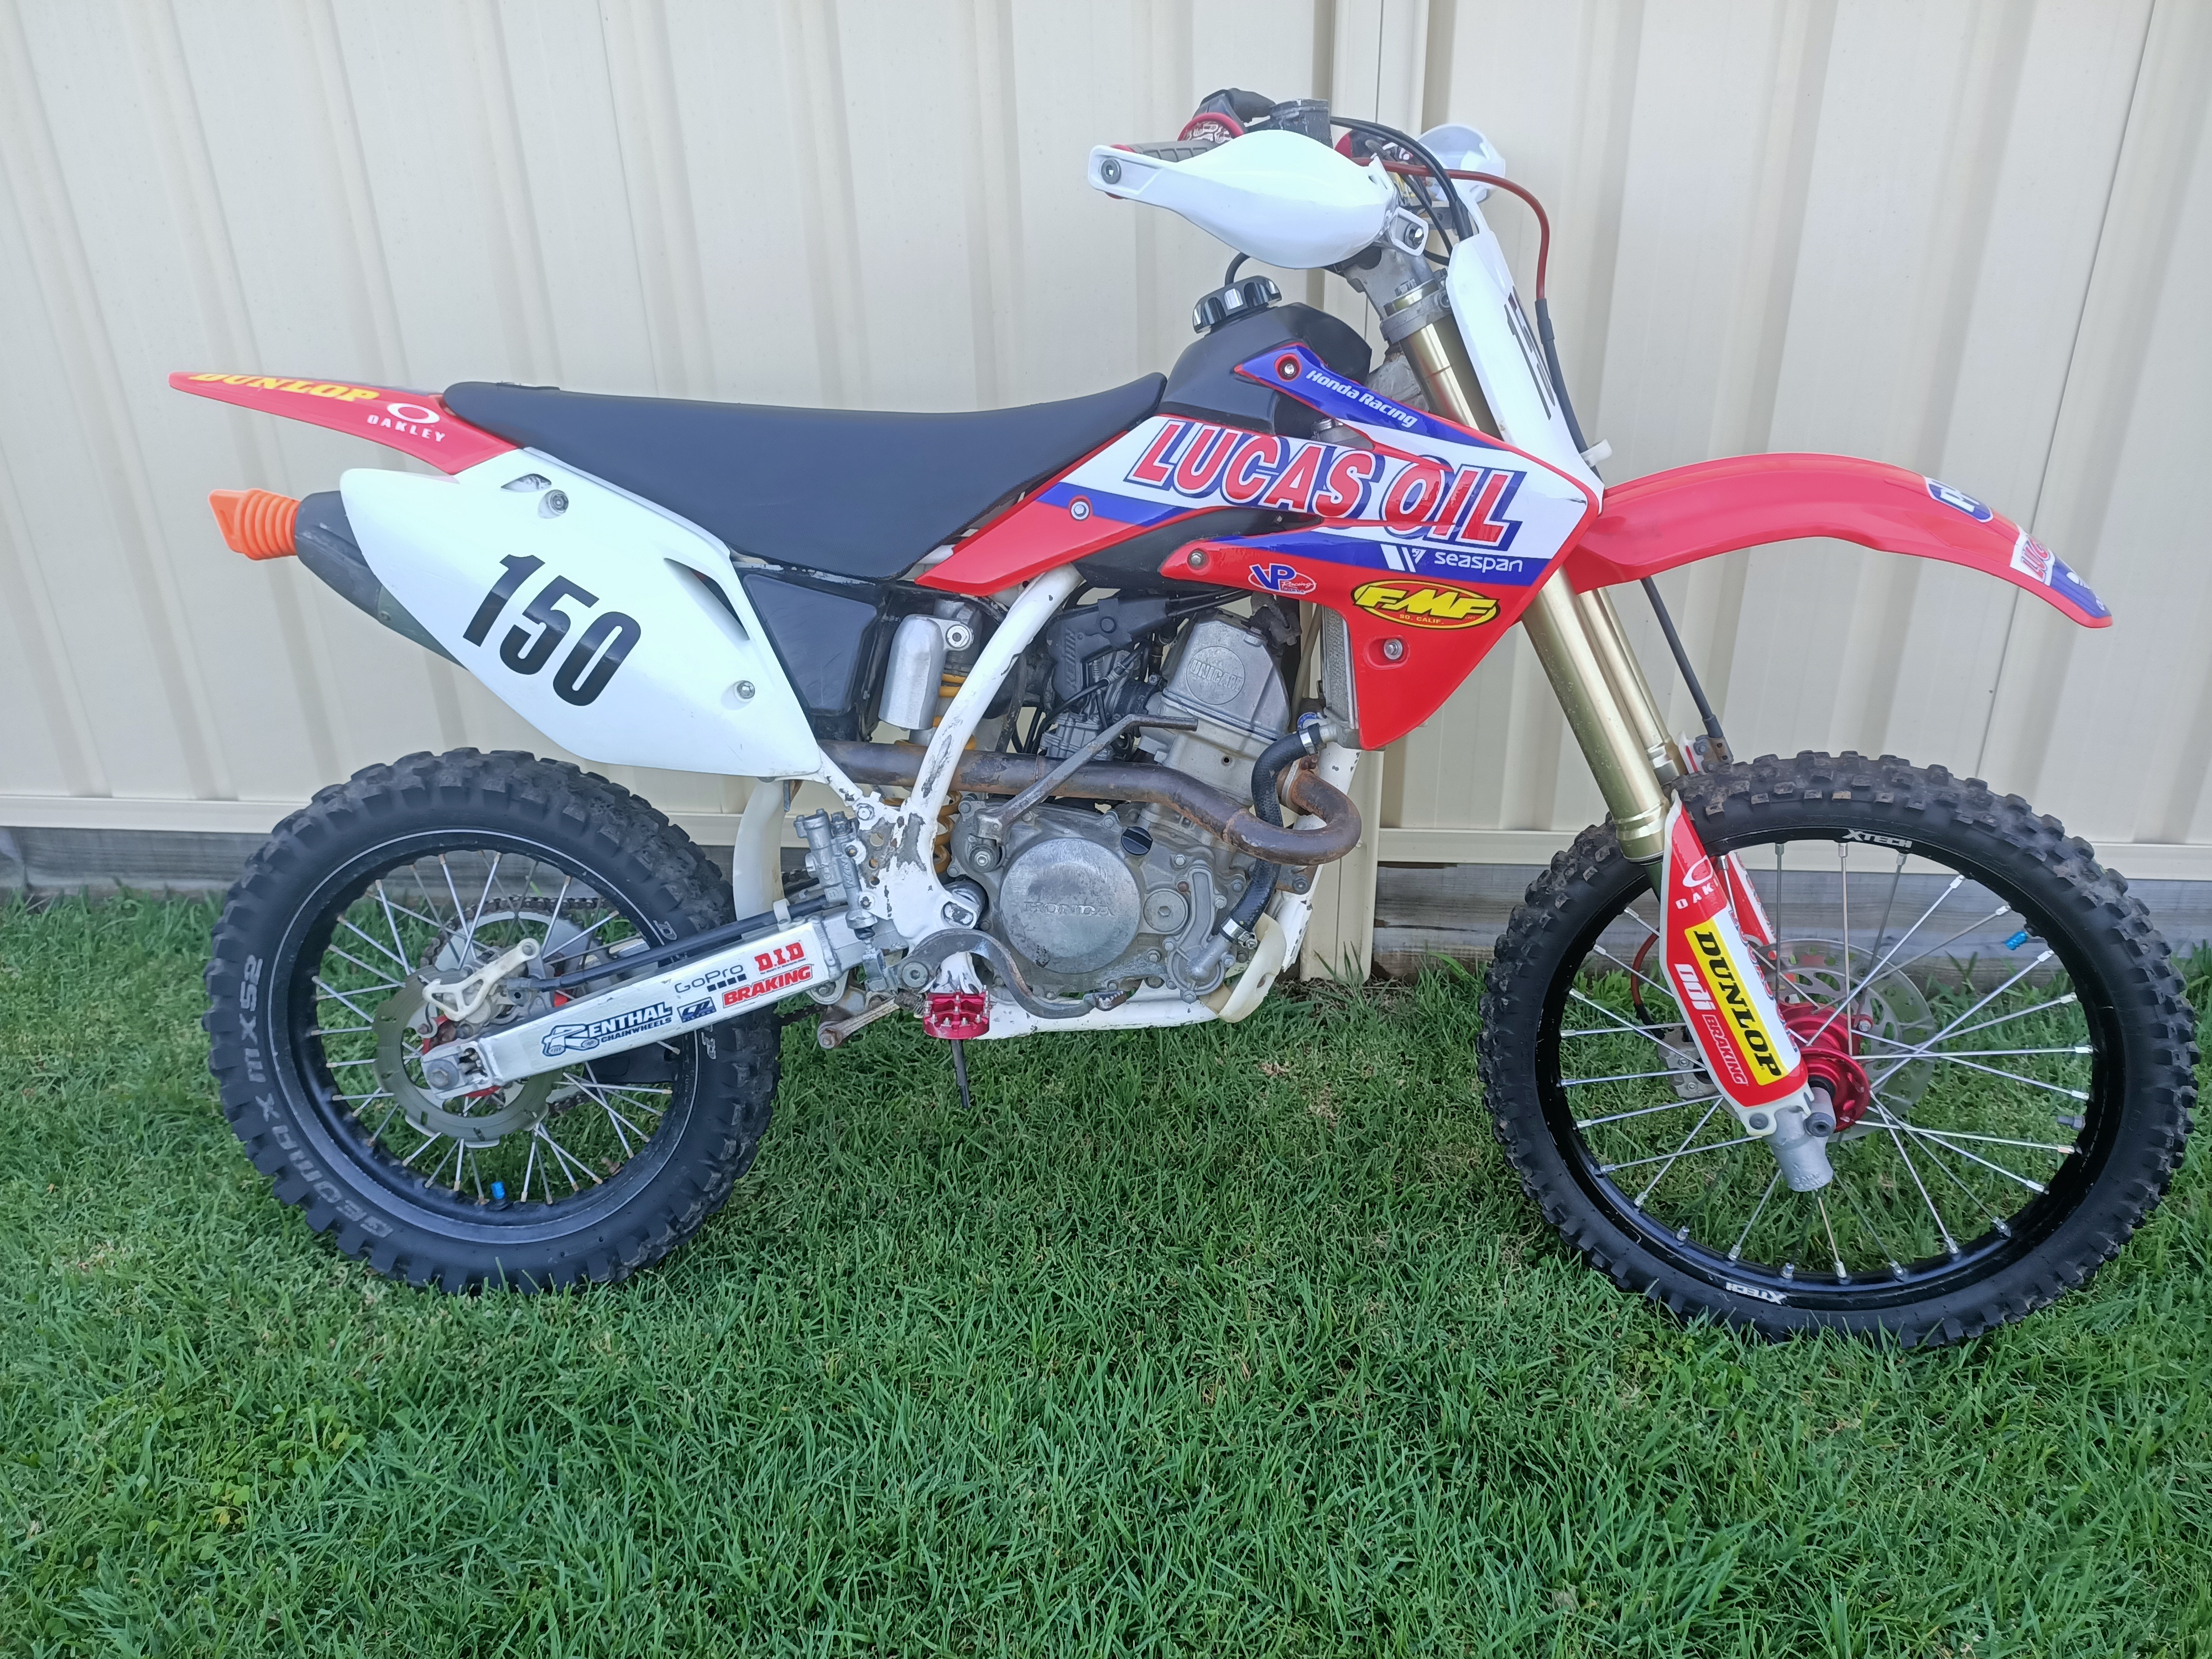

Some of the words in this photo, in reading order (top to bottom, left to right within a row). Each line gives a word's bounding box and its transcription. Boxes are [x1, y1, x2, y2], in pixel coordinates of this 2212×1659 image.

[188, 373, 380, 402] DUNLOP
[1305, 370, 1360, 399] Honda
[1358, 393, 1418, 428] Racing
[367, 414, 446, 442] OAKLEY
[1125, 420, 1384, 527] LUCAS
[1380, 456, 1527, 551] OIL
[1249, 562, 1297, 592] VP
[1434, 551, 1523, 573] seaspan
[1353, 585, 1500, 620] FMF
[463, 554, 641, 707] 150
[1190, 659, 1243, 692] UNICAM
[1842, 829, 1913, 848] XTECH
[1023, 901, 1115, 916] HONDA
[1675, 878, 1719, 910] OAK
[674, 964, 744, 994] GoPro
[722, 964, 812, 1008] BRAKING
[1693, 930, 1782, 1076] DUNLOP
[541, 1001, 673, 1057] RENTHAL
[601, 1016, 672, 1043] CHAINWHEELS
[1701, 1014, 1749, 1086] BRAKING
[255, 1092, 394, 1238] GEOMAX
